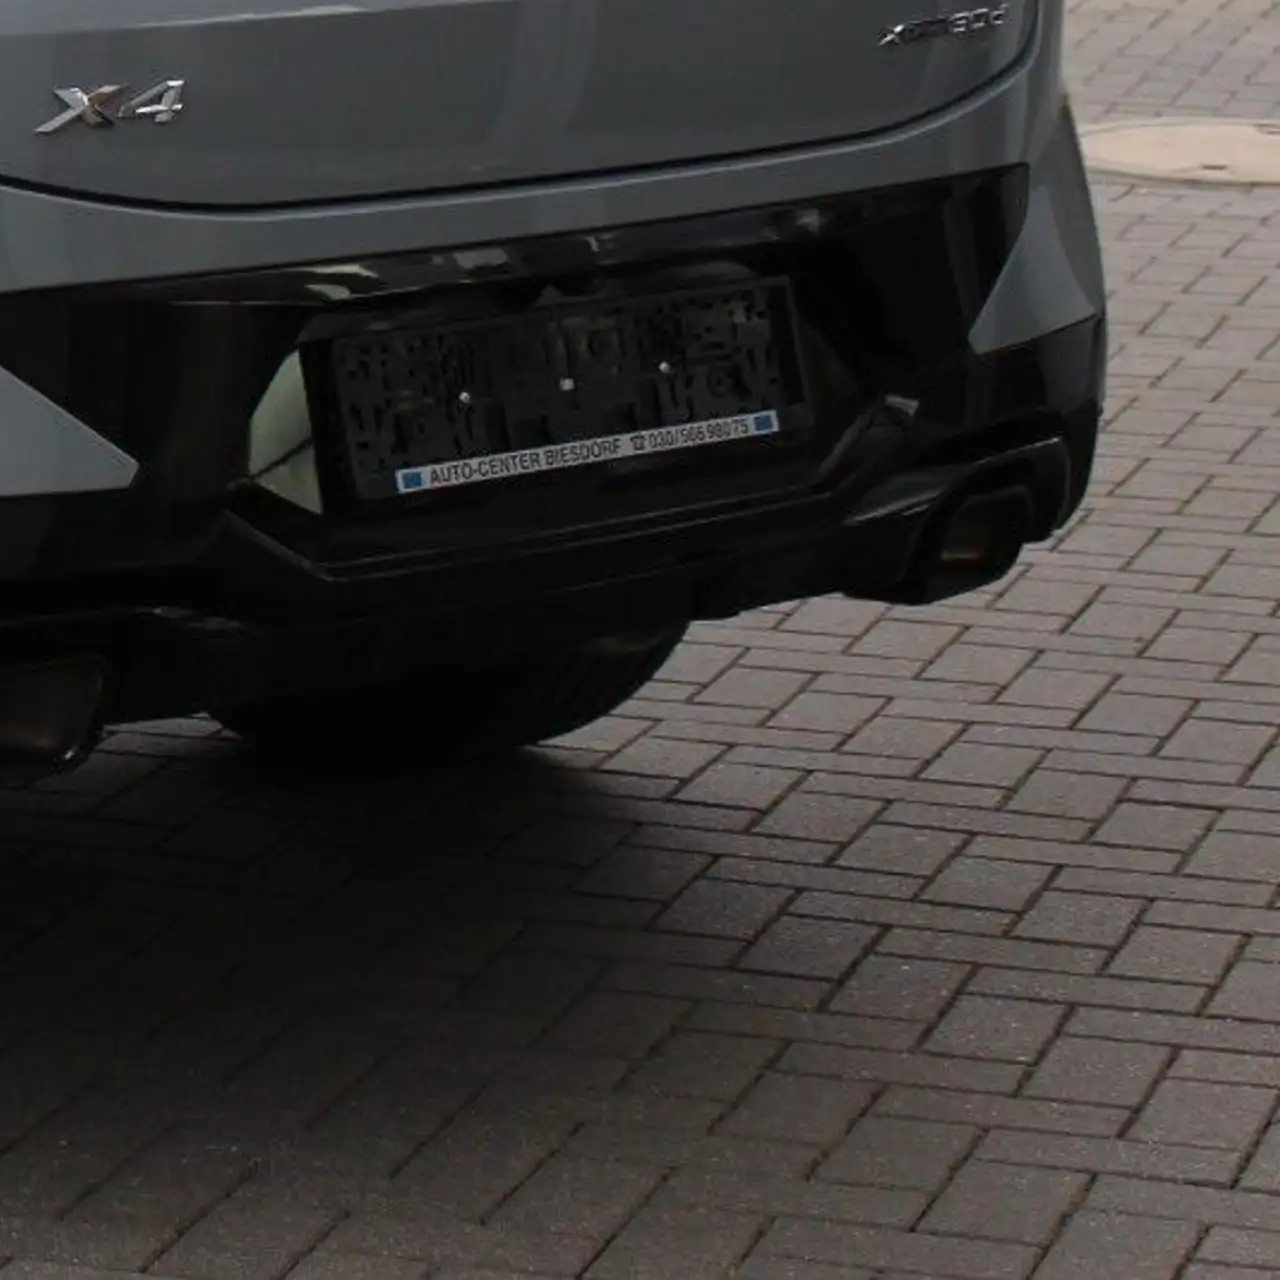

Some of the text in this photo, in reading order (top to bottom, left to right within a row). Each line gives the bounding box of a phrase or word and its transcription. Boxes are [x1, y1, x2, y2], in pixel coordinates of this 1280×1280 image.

[33, 79, 186, 134] X4
[429, 451, 542, 486] AUTO-CENTER
[544, 437, 622, 467] BIESDORF
